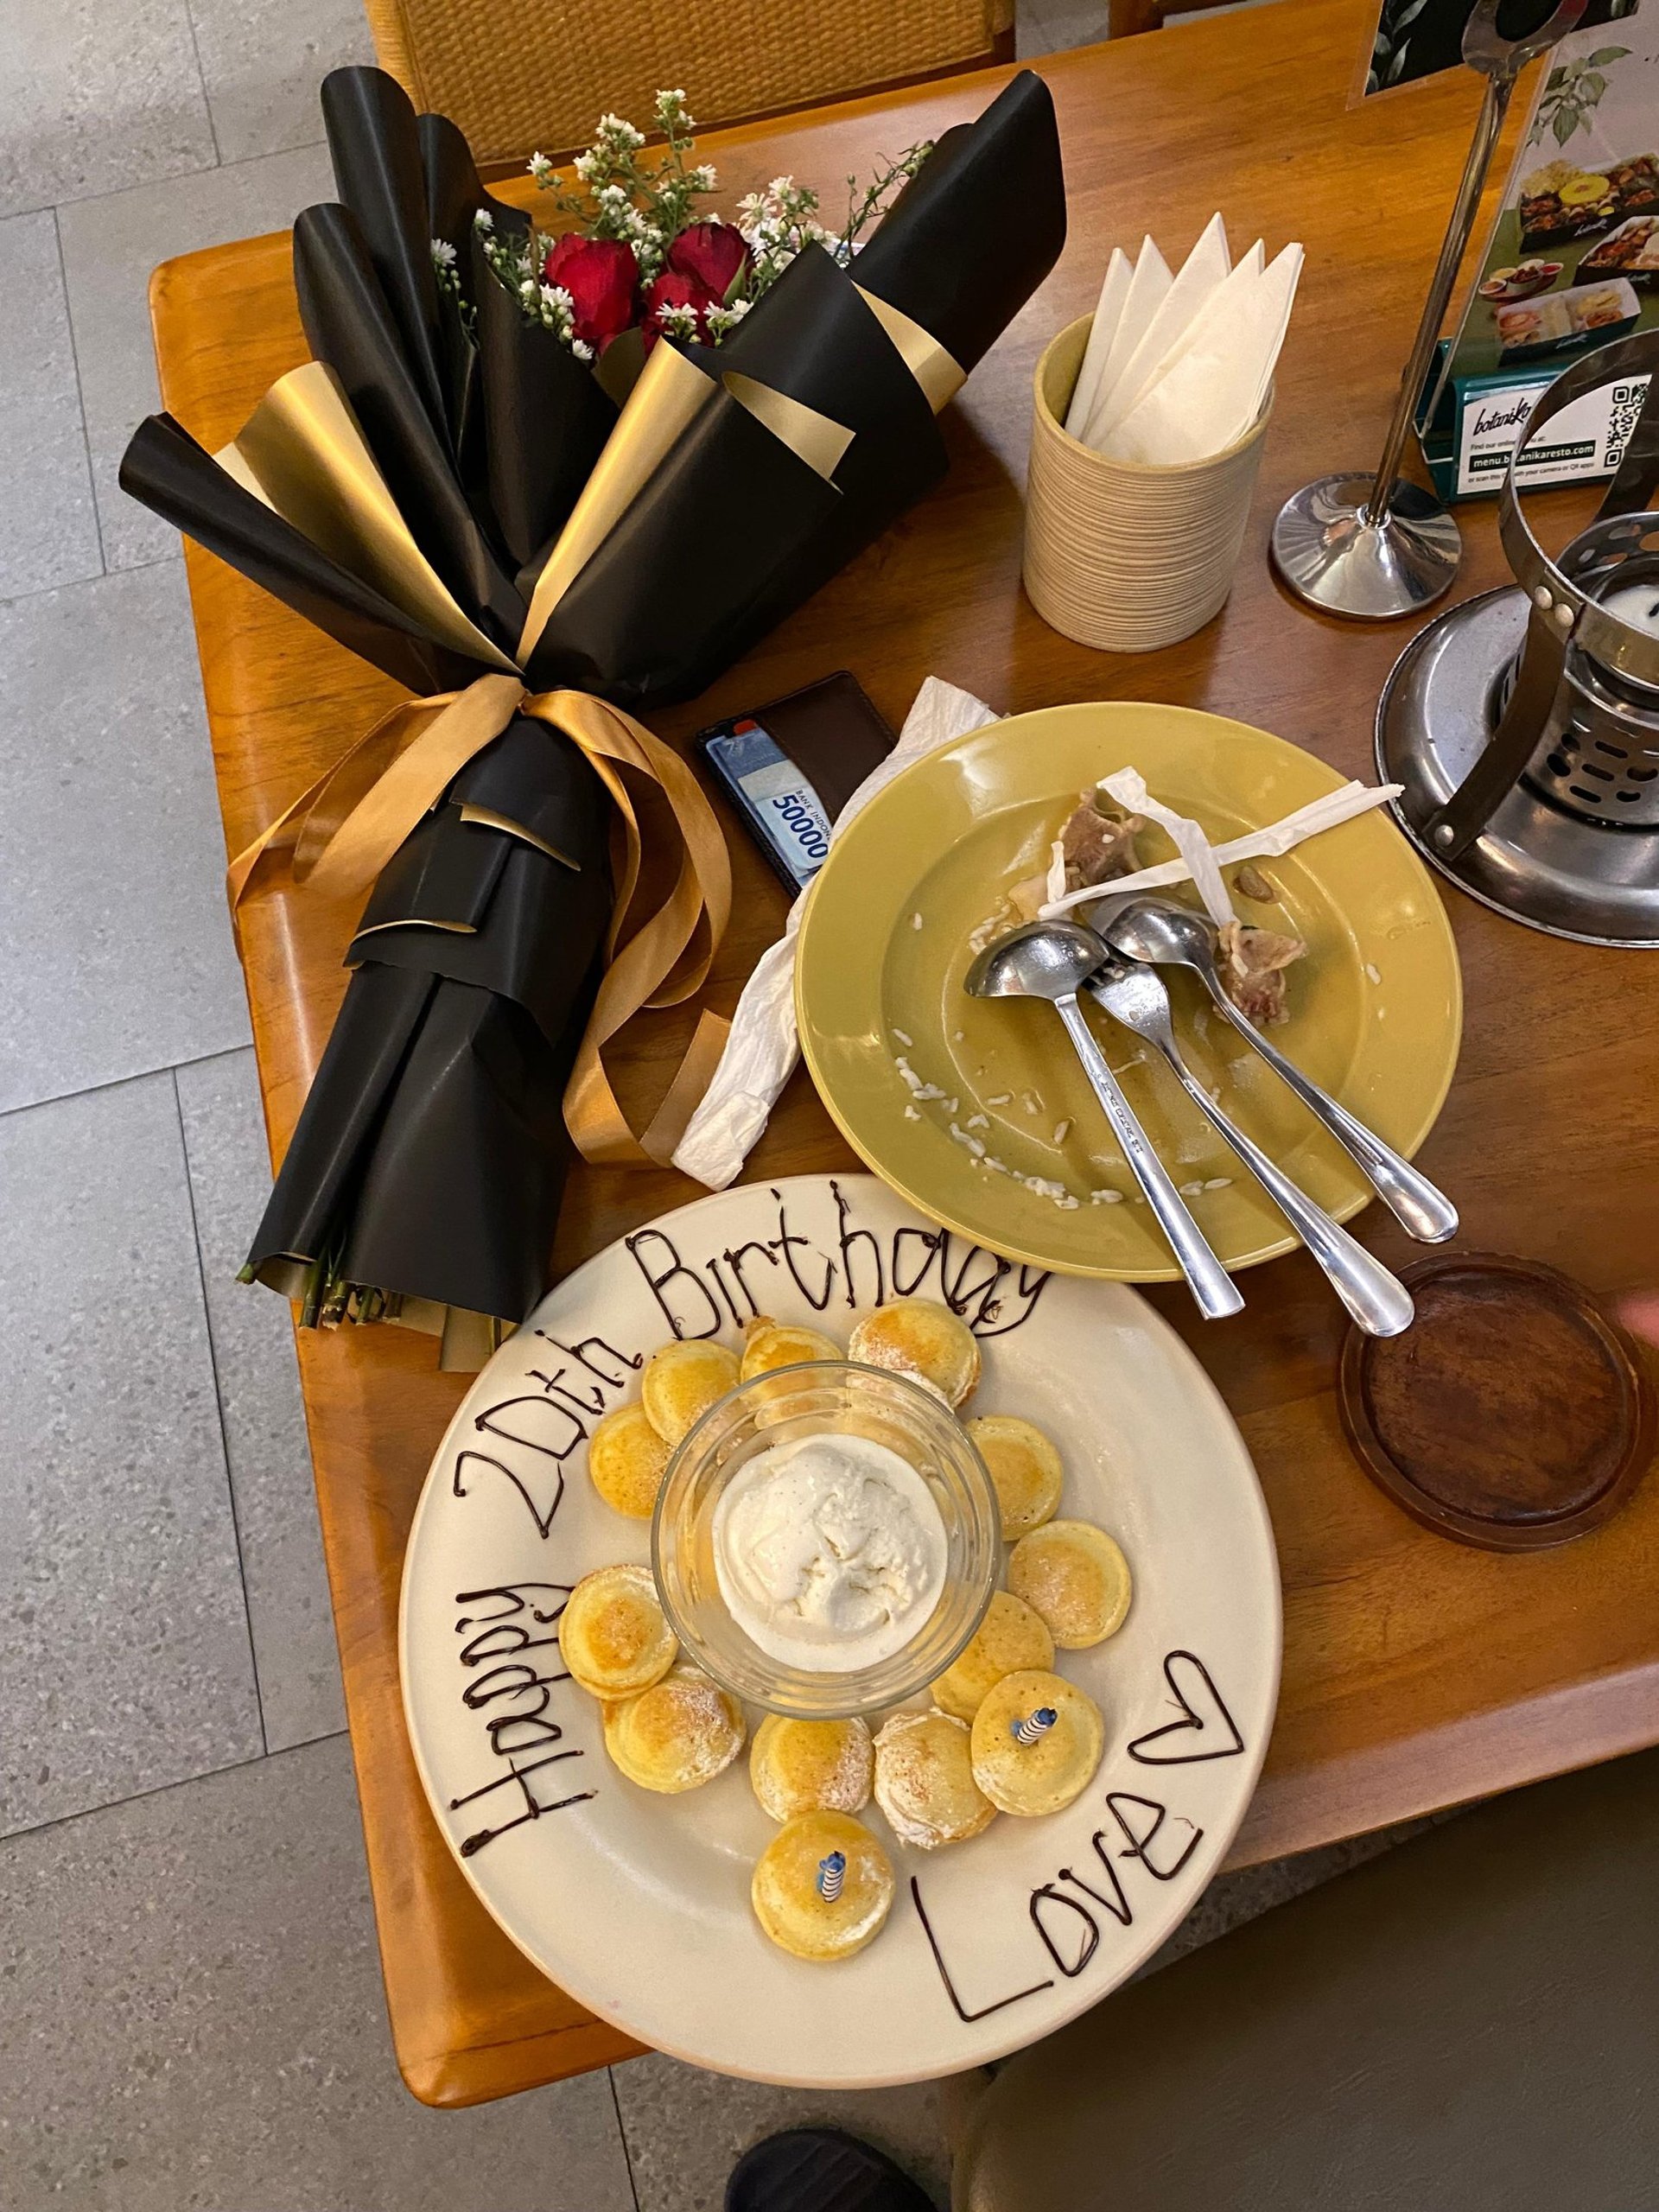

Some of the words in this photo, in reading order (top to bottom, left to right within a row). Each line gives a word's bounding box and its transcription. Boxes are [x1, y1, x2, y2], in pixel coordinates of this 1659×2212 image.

[1473, 446, 1593, 467] menu.banikaresto.com
[772, 795, 829, 858] 50000
[796, 789, 813, 809] BANK
[450, 1583, 598, 1858] Happy
[624, 1180, 1056, 1340] Birthday
[911, 1792, 1204, 2022] Love
